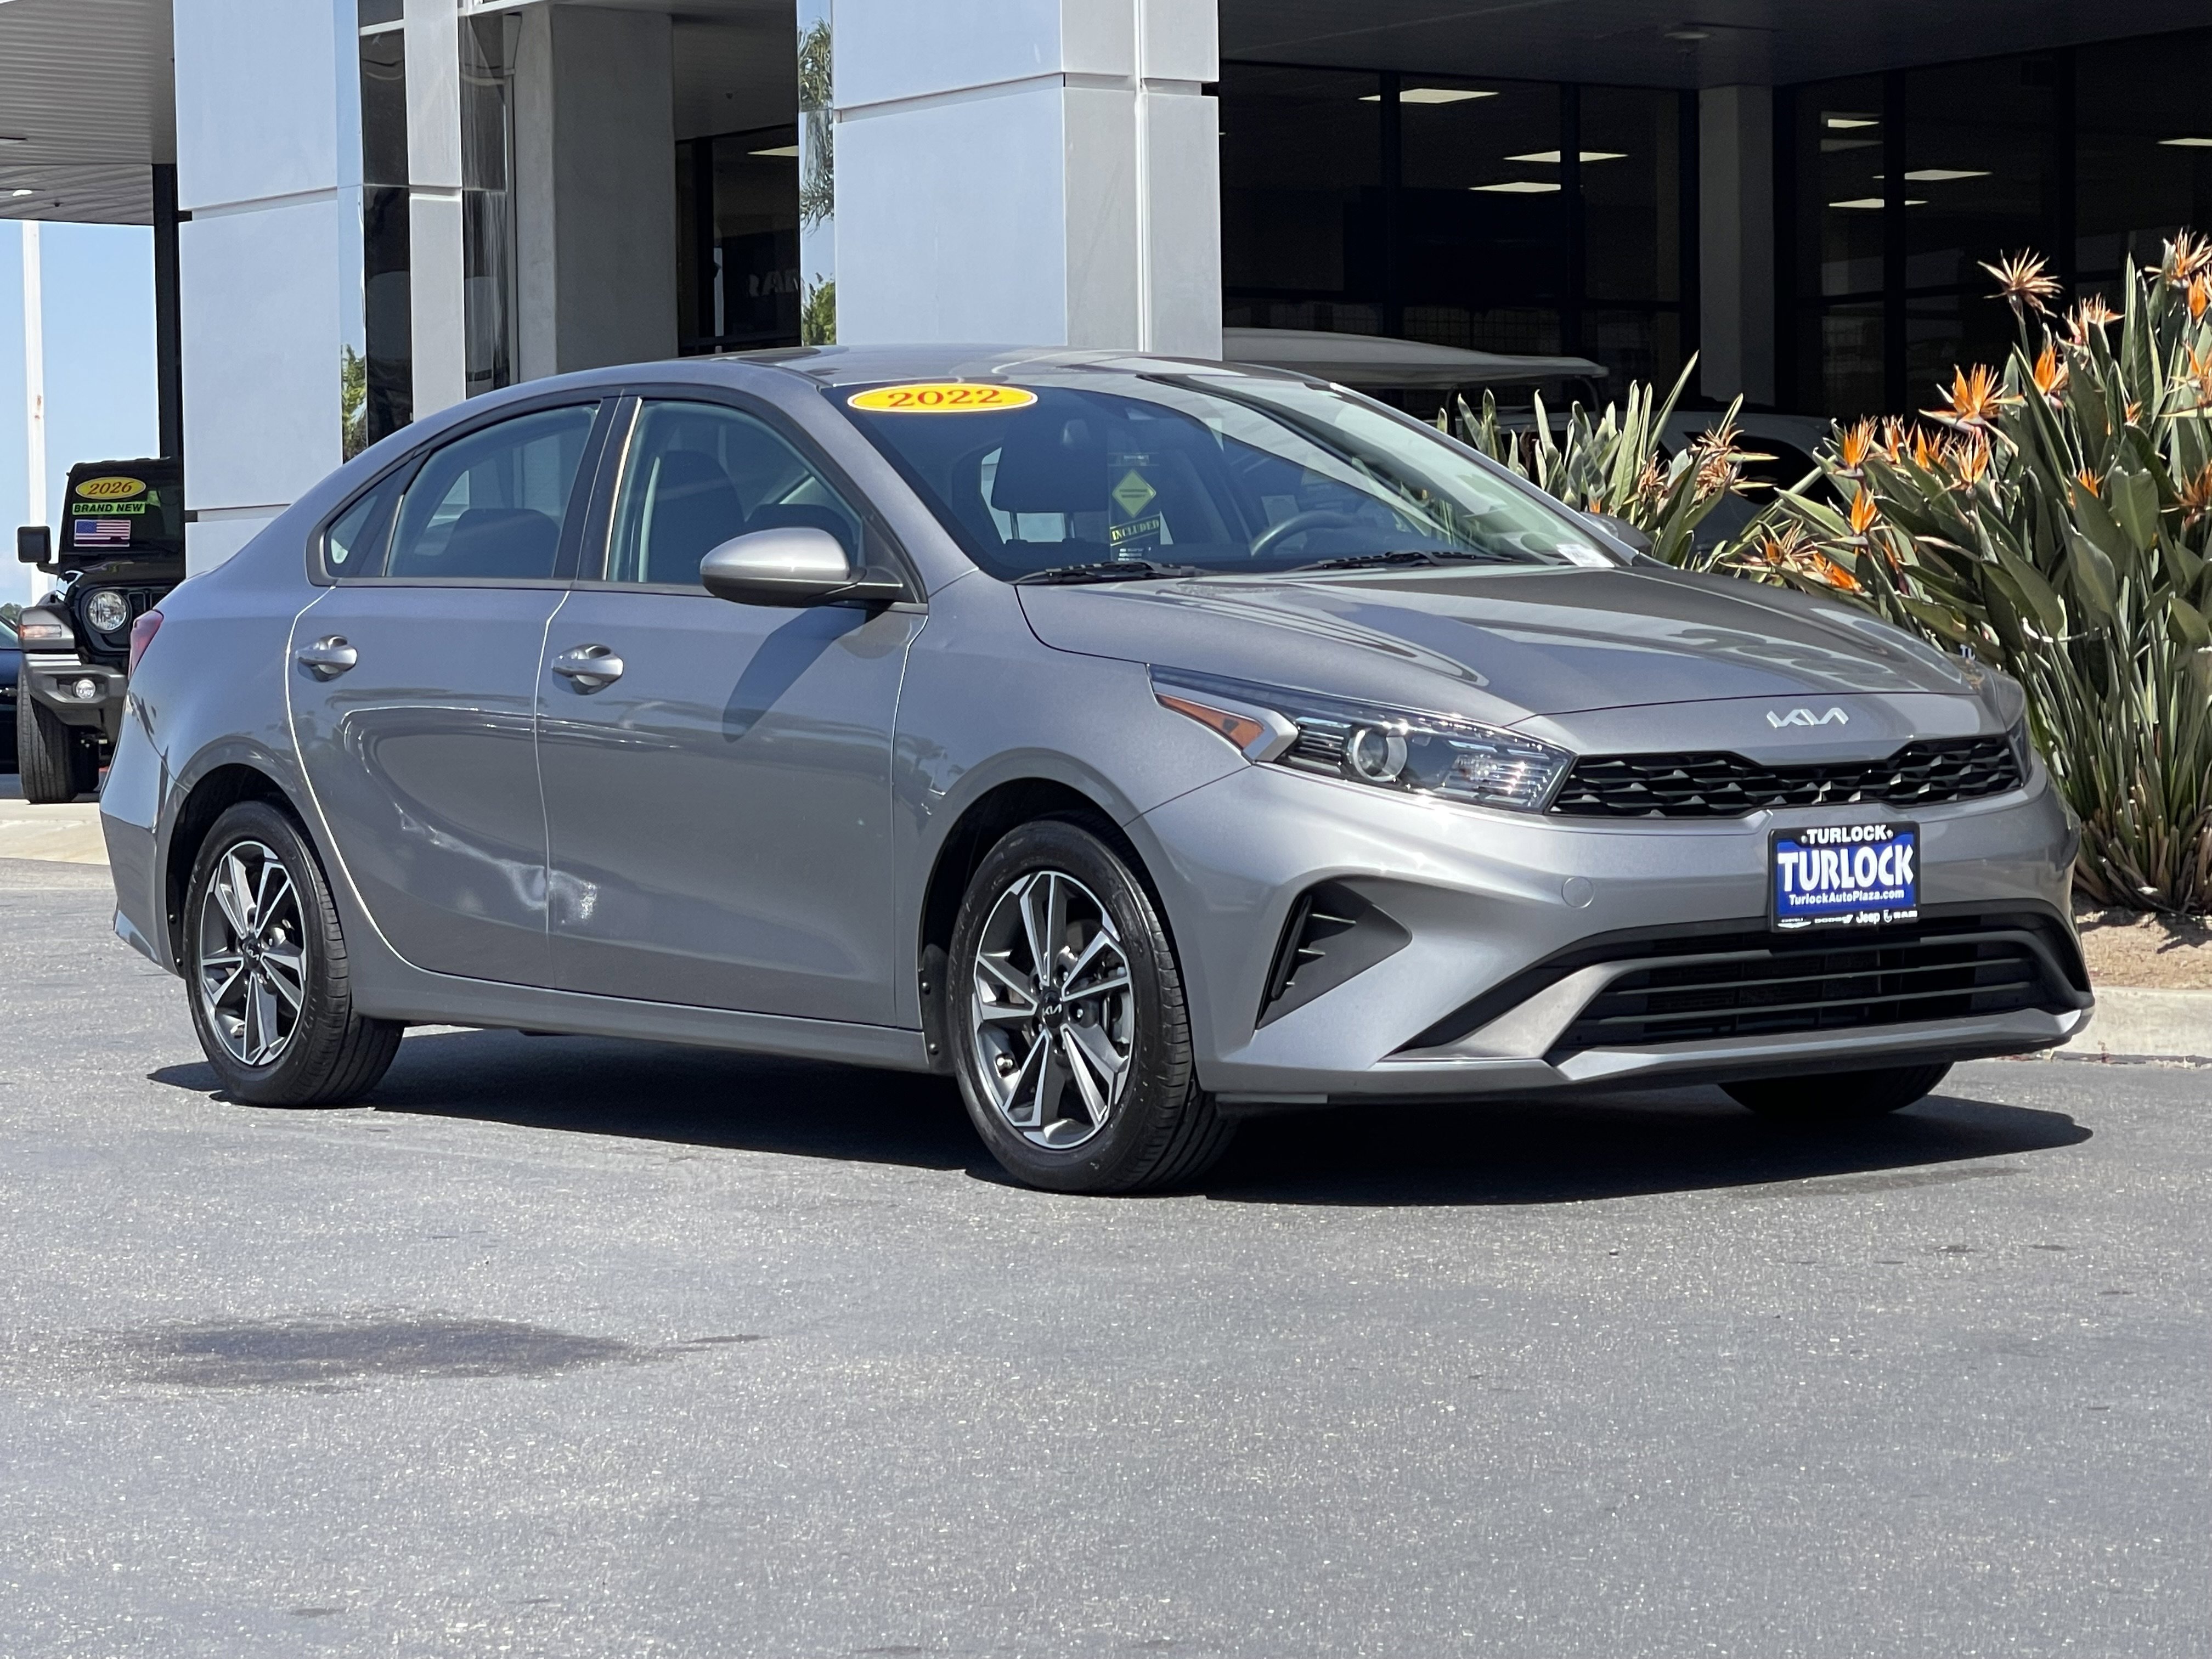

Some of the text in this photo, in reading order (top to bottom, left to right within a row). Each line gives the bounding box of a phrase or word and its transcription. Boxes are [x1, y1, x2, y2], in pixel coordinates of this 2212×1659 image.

[888, 390, 1002, 407] 2022
[87, 481, 134, 495] 2026
[74, 503, 142, 512] BRAND NEW
[1112, 520, 1159, 540] INCLUDED
[1807, 825, 1887, 844] TURLOCK
[1778, 844, 1914, 891] TURLOCK
[1789, 890, 1904, 906] TurlockAutoPlaza.com
[1856, 911, 1880, 924] Jeep
